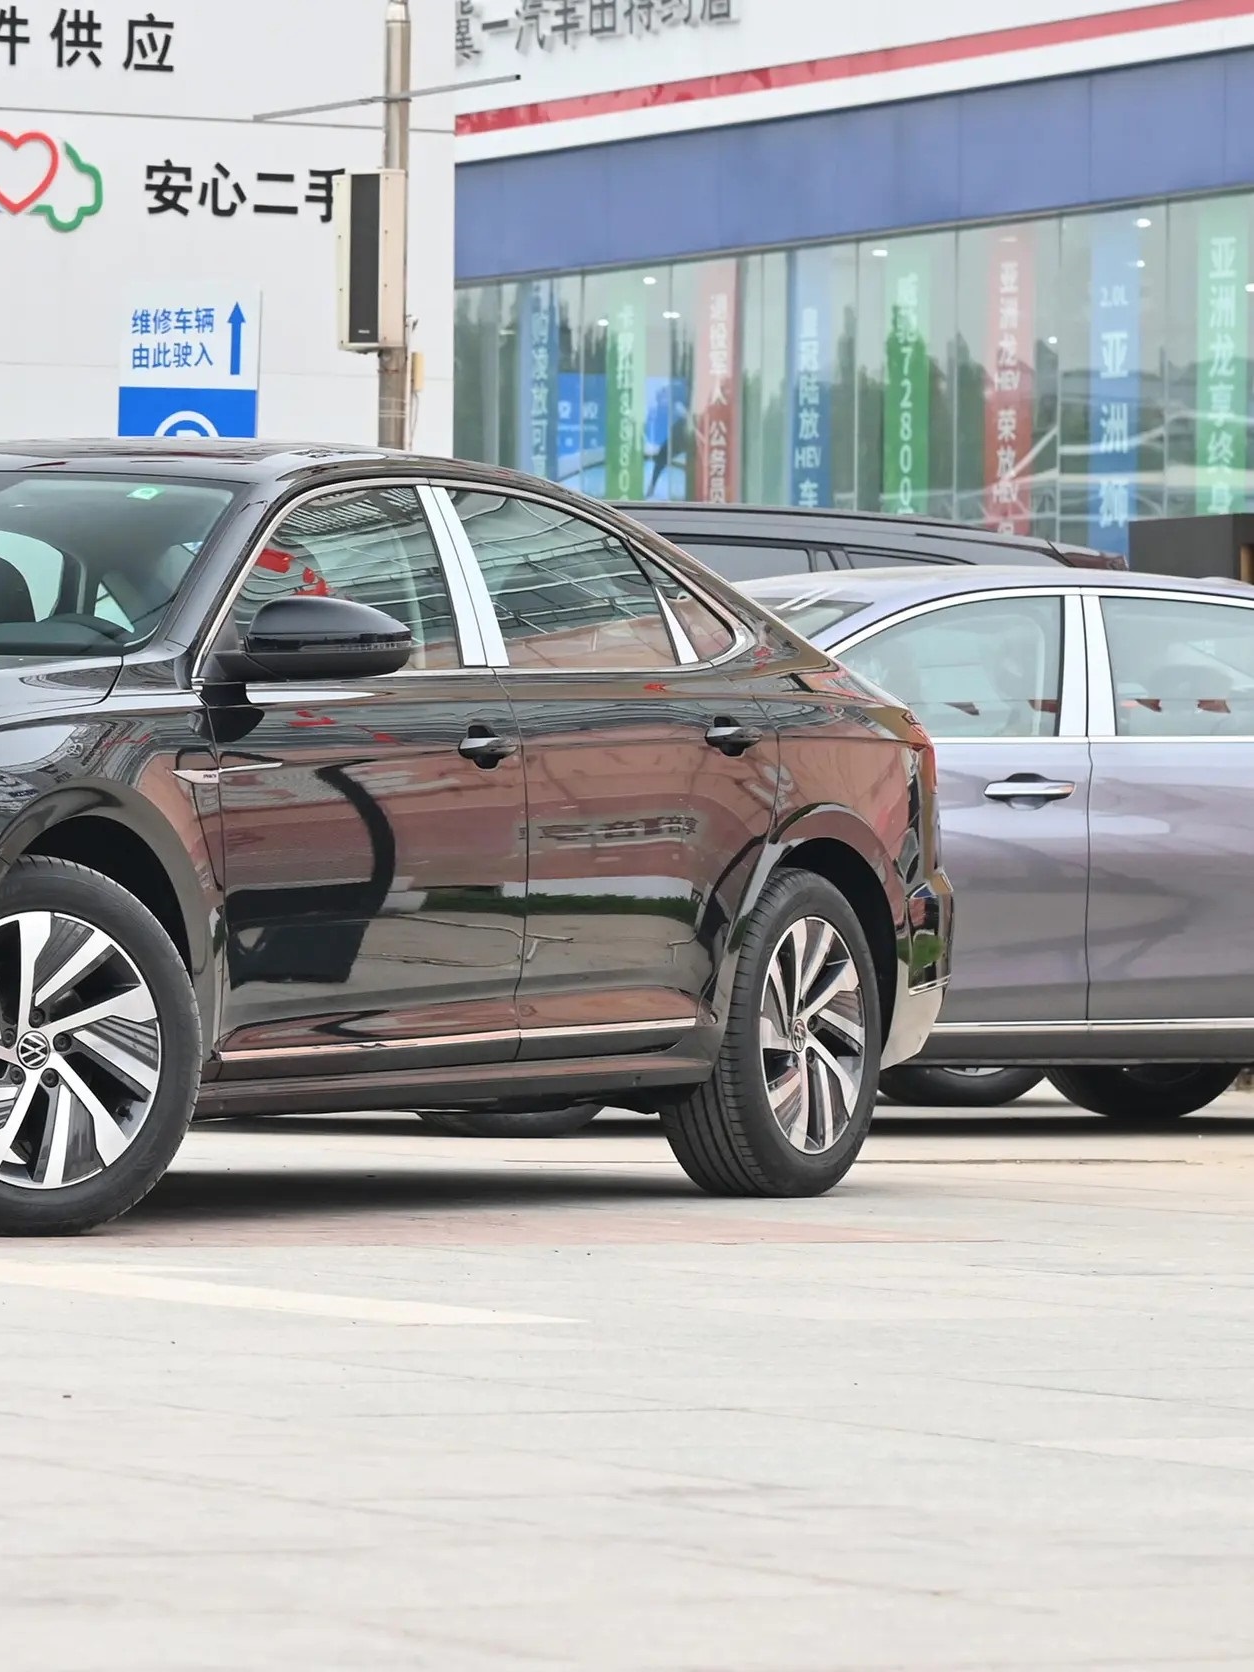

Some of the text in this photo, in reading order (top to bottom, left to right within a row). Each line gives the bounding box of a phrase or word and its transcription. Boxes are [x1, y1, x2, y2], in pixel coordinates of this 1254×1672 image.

[131, 307, 215, 335] 维修车辆
[131, 342, 214, 369] 由此驶入
